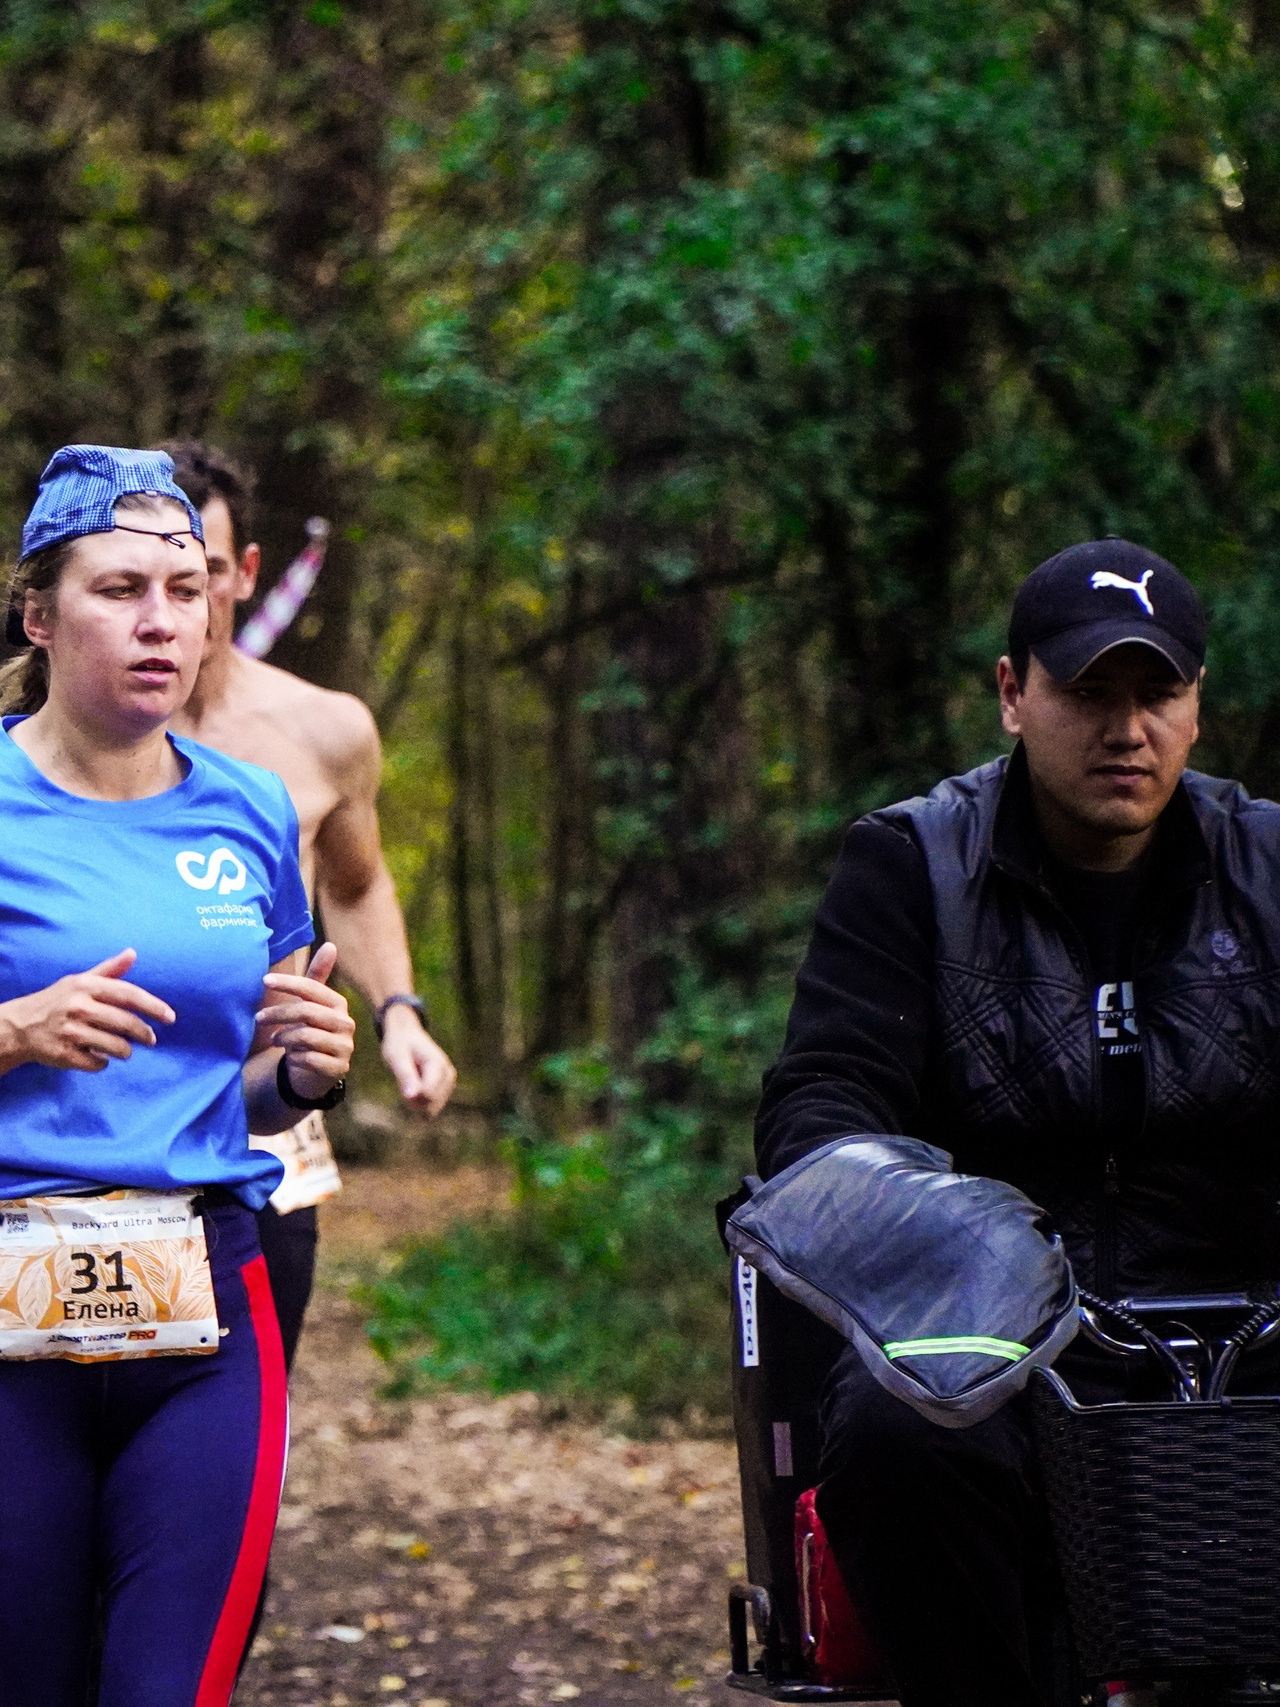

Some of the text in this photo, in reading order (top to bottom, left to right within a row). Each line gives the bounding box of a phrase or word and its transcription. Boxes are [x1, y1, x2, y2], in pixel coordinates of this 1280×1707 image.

[72, 1215, 186, 1231] Backyard Ultra Moscow
[71, 1251, 133, 1294] 31
[63, 1300, 139, 1320] Елена
[128, 1330, 157, 1340] PRO
